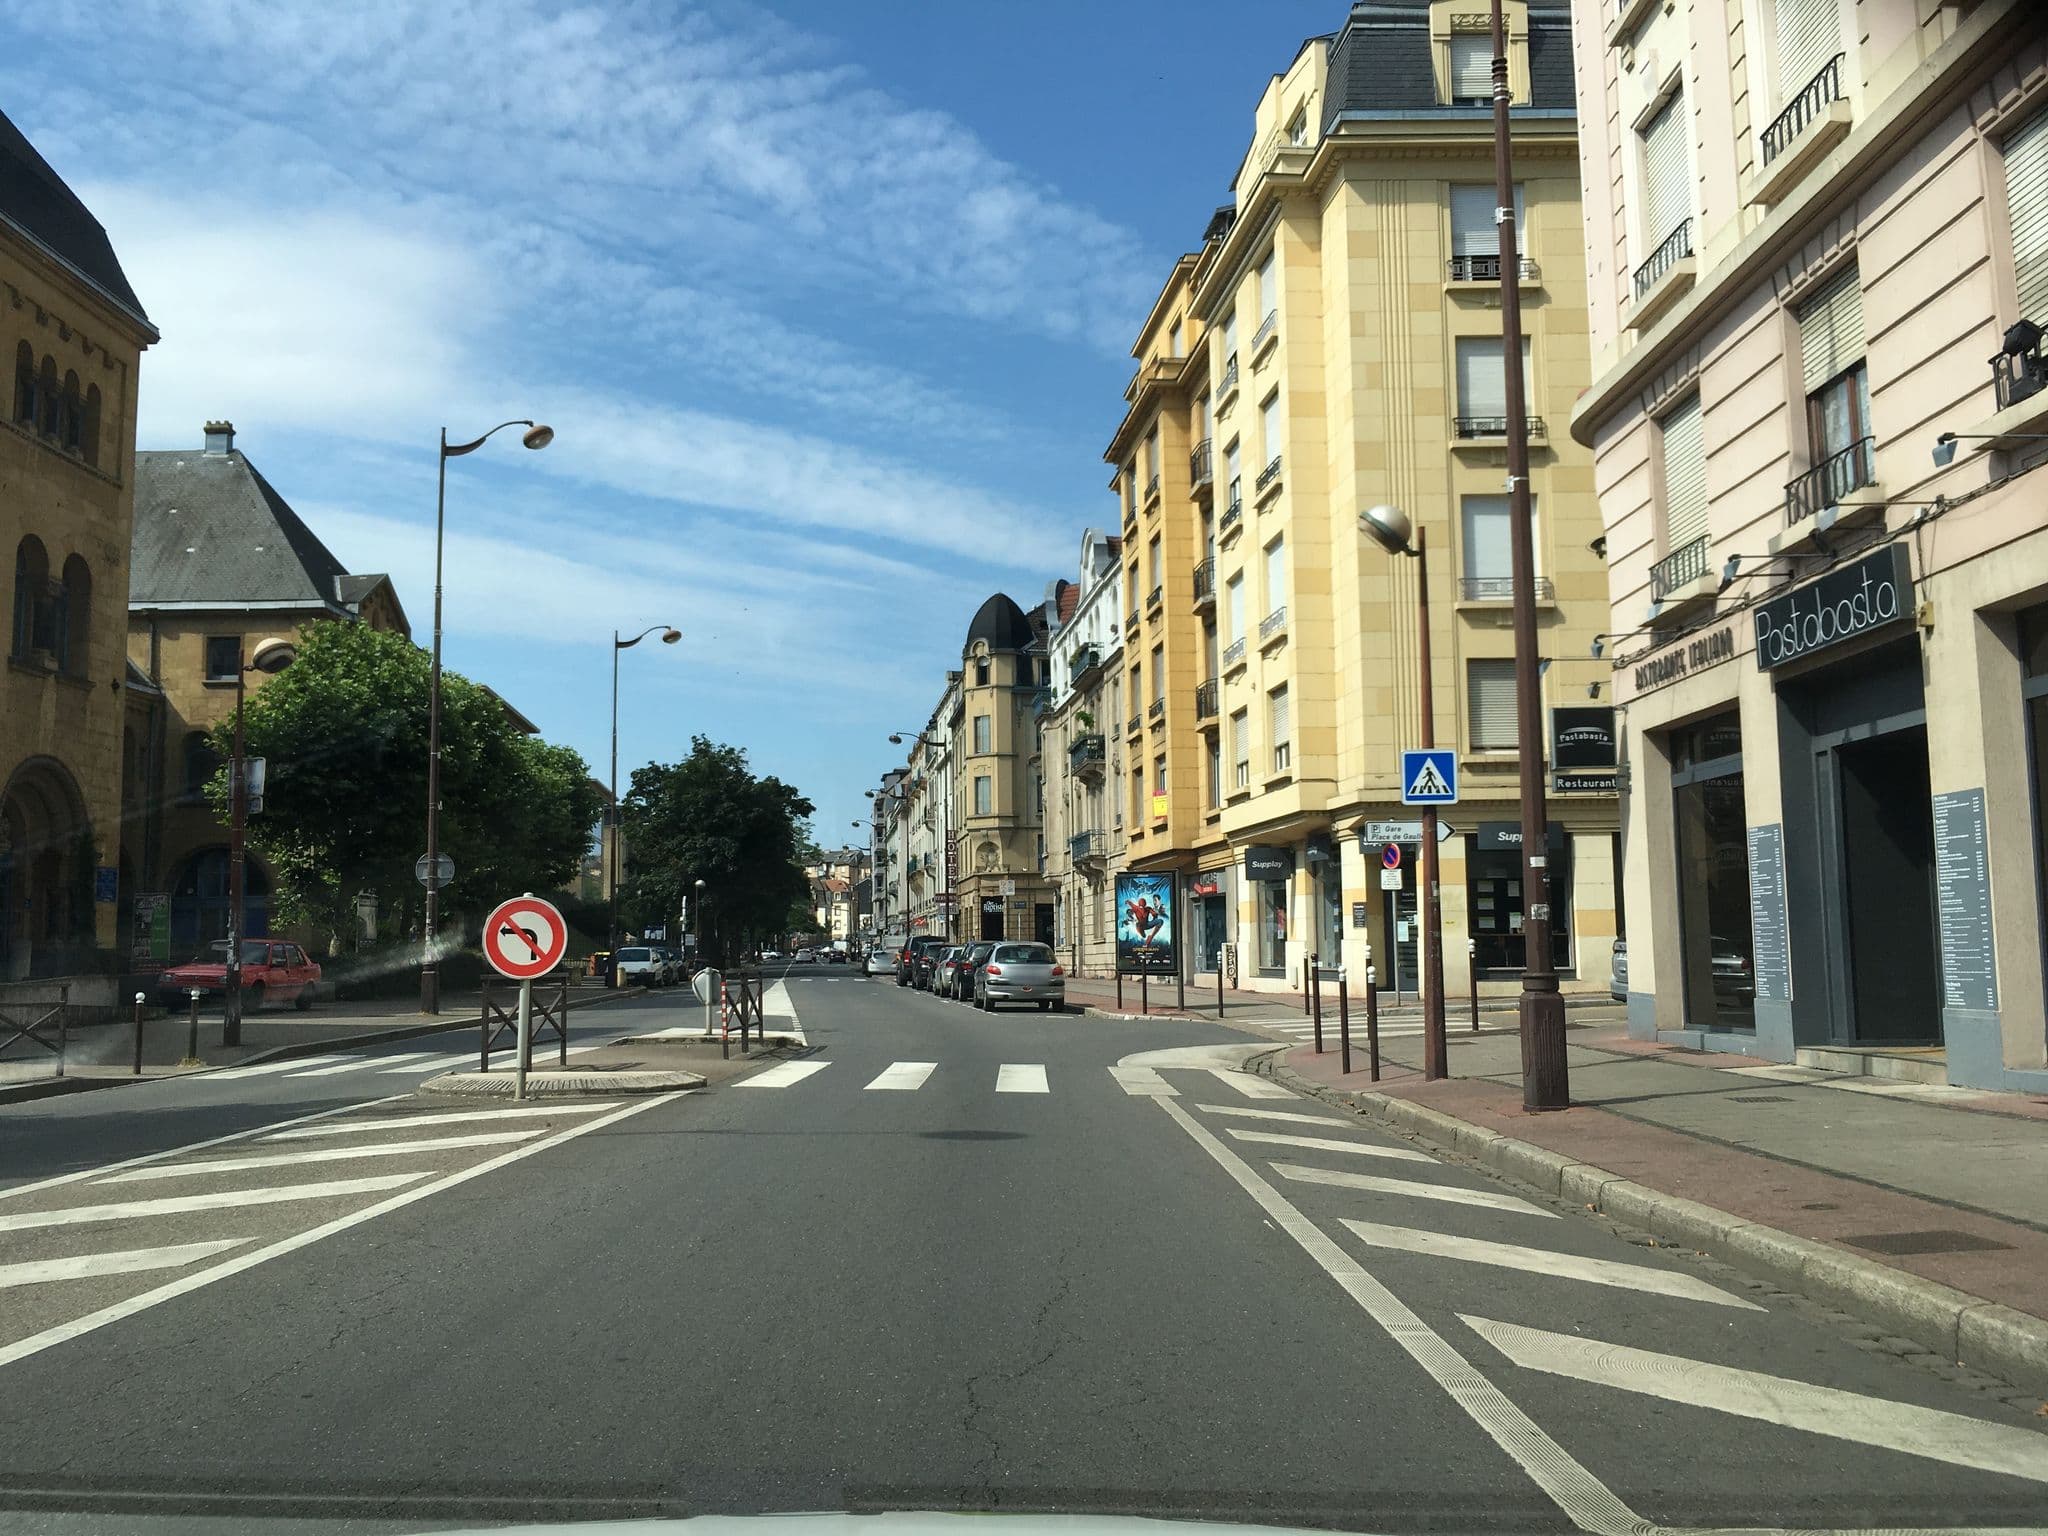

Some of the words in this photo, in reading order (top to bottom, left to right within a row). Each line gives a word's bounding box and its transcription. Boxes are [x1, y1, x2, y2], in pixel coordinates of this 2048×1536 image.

[1757, 566, 1897, 666] Pastabasta
[1635, 647, 1687, 690] RISTORANTE
[1688, 626, 1735, 670] ITALIANO
[1559, 730, 1609, 743] Pastabasta
[1557, 777, 1617, 788] Restaurant
[947, 831, 956, 888] HOTEL
[1251, 860, 1283, 870] Supplay
